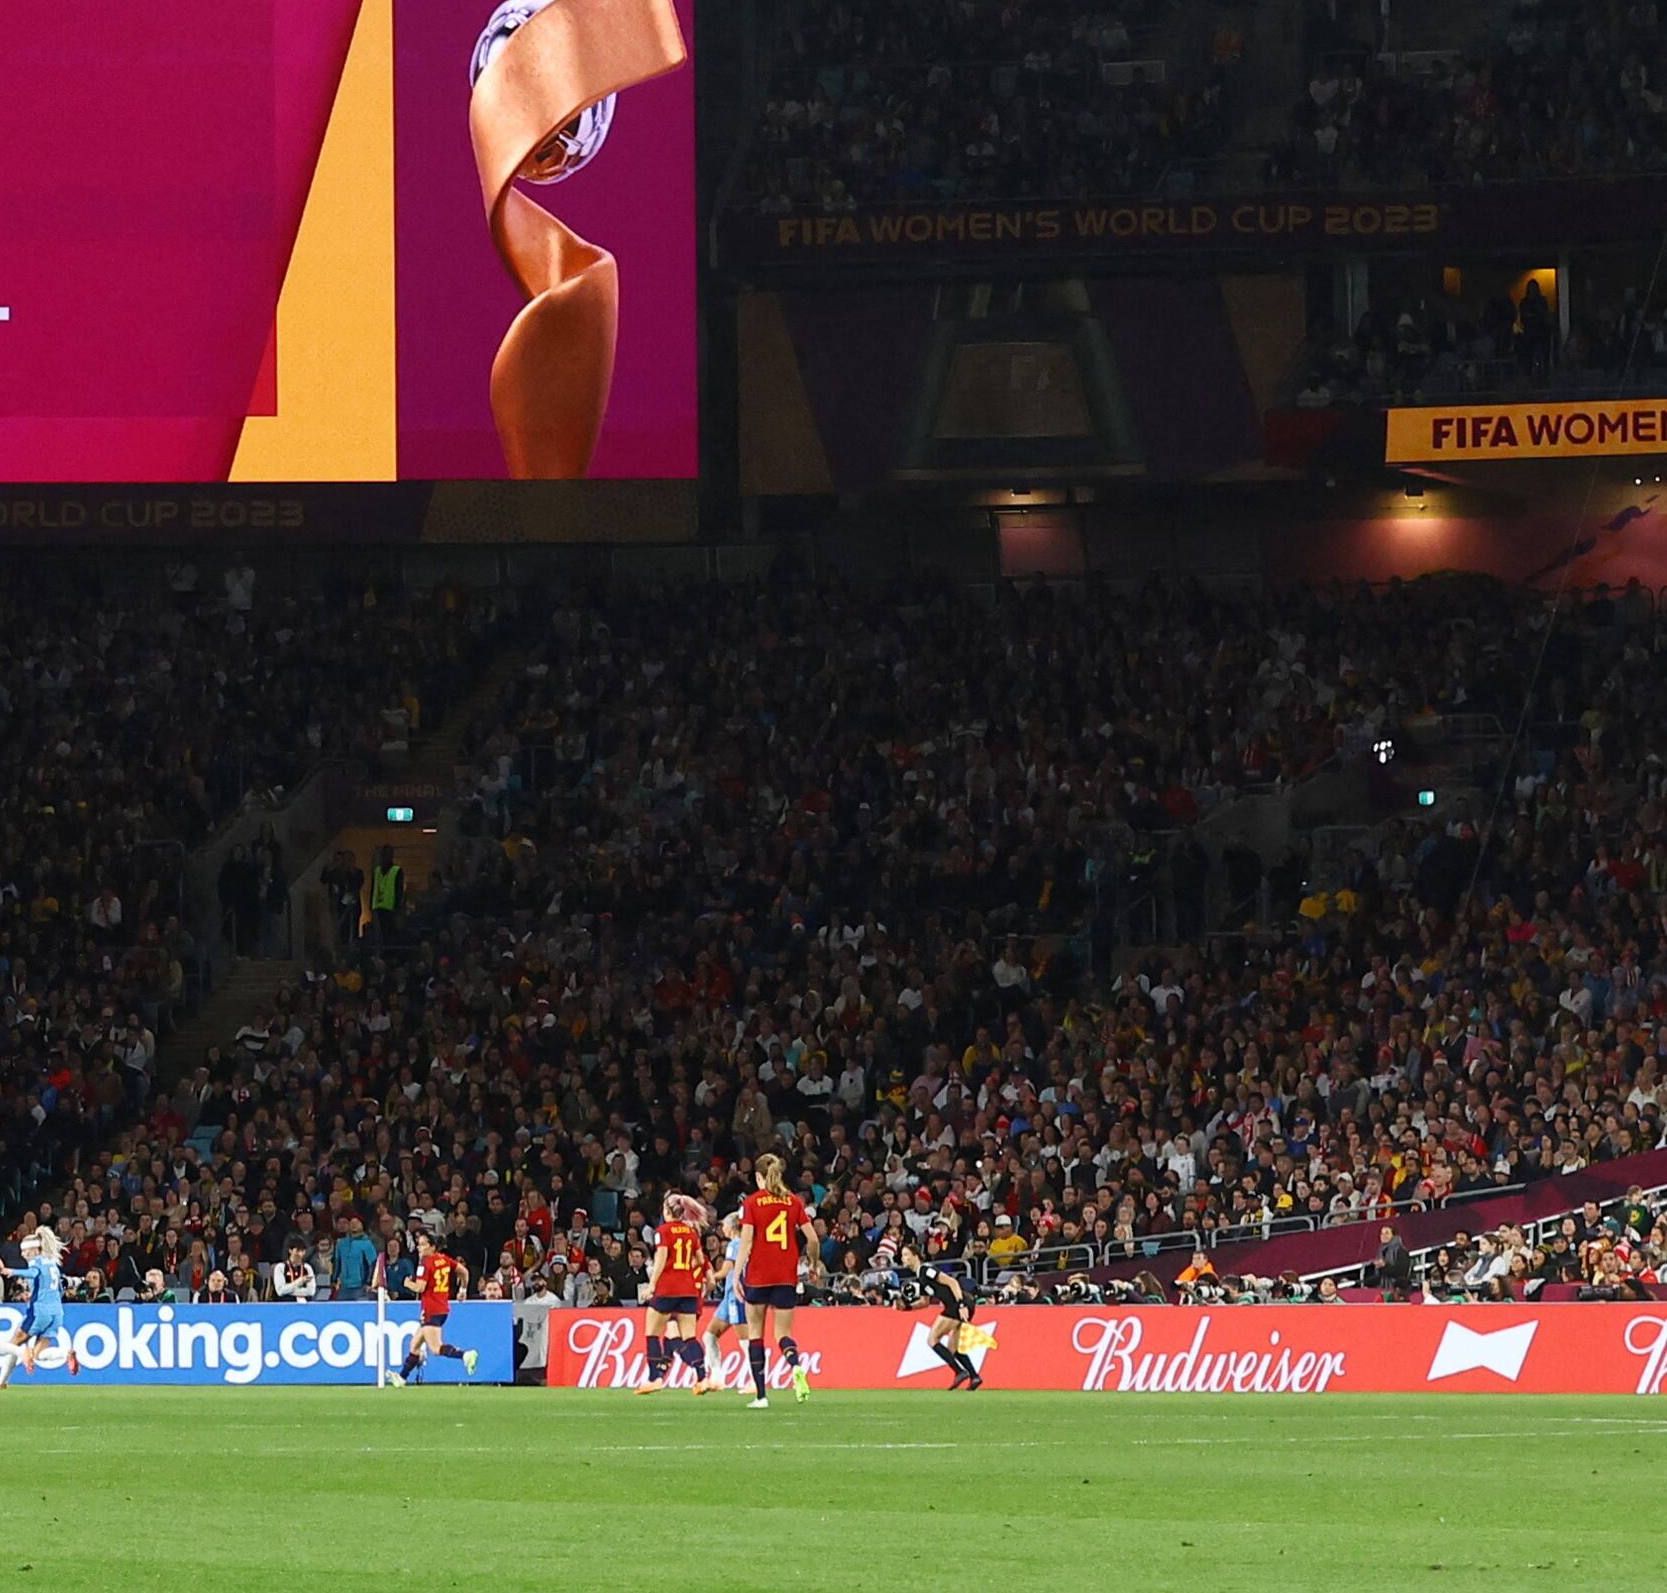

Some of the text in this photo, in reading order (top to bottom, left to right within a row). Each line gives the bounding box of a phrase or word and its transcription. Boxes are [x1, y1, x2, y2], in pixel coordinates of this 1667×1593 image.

[778, 204, 1440, 247] FIFA WOMEN'S WORLD CUP 2023
[1432, 416, 1518, 449] FIFA
[101, 501, 179, 529] CUP
[190, 500, 306, 529] 2023
[766, 1210, 788, 1250] 4
[673, 1238, 692, 1270] 11
[1072, 1316, 1345, 1392] Budweiser
